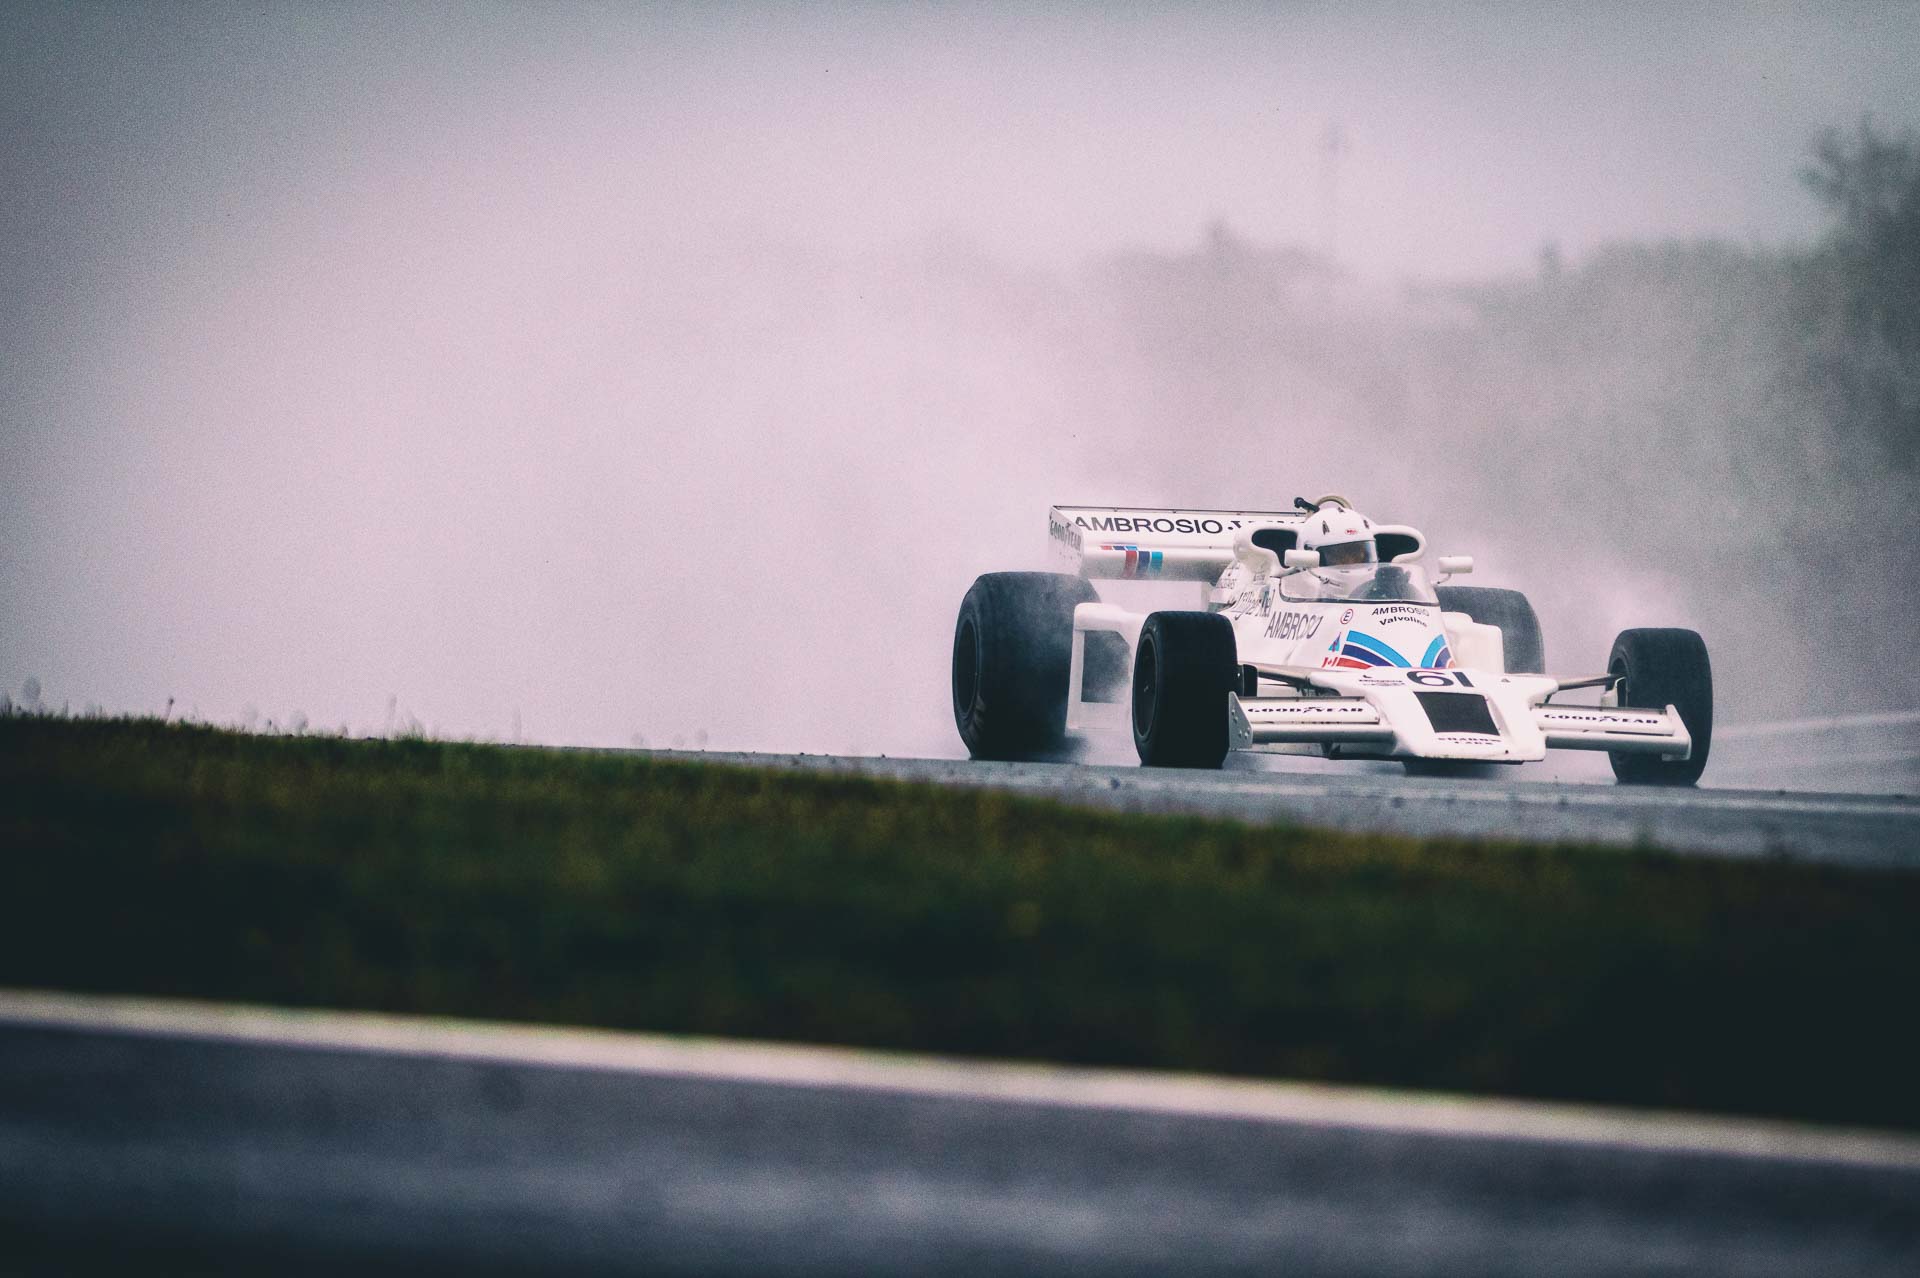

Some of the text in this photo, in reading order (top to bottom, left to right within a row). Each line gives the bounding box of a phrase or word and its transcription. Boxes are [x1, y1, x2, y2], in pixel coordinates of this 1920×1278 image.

[1074, 515, 1223, 534] AMBROSIO
[1406, 670, 1474, 688] 61
[1247, 706, 1364, 714] GOODYEAR
[1544, 714, 1659, 724] GOODYEAR
